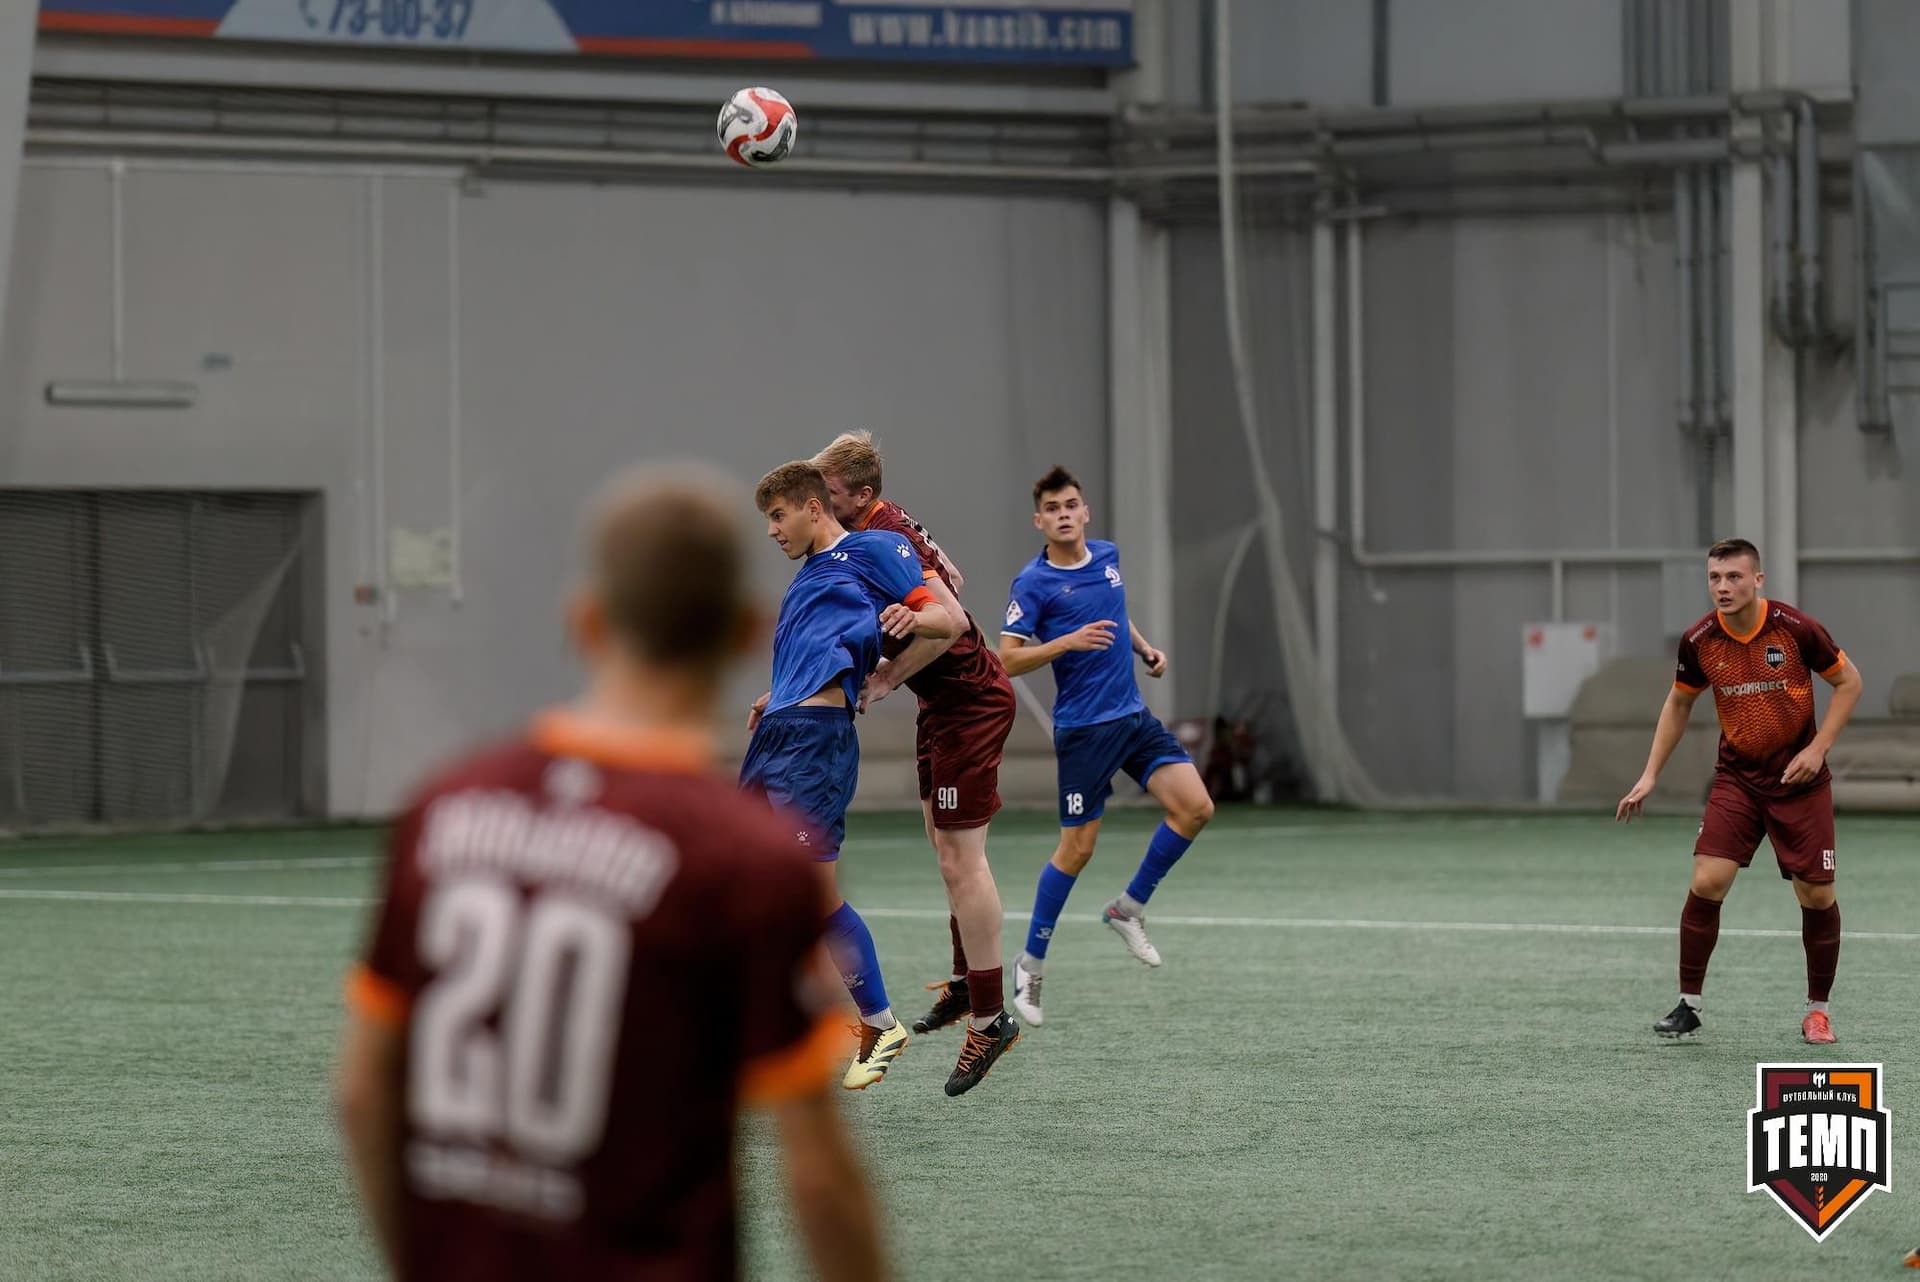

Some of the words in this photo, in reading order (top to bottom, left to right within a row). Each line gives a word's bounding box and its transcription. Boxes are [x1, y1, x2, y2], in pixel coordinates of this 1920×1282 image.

[938, 787, 958, 809] 90
[1066, 793, 1084, 815] 18
[408, 880, 633, 1163] 20
